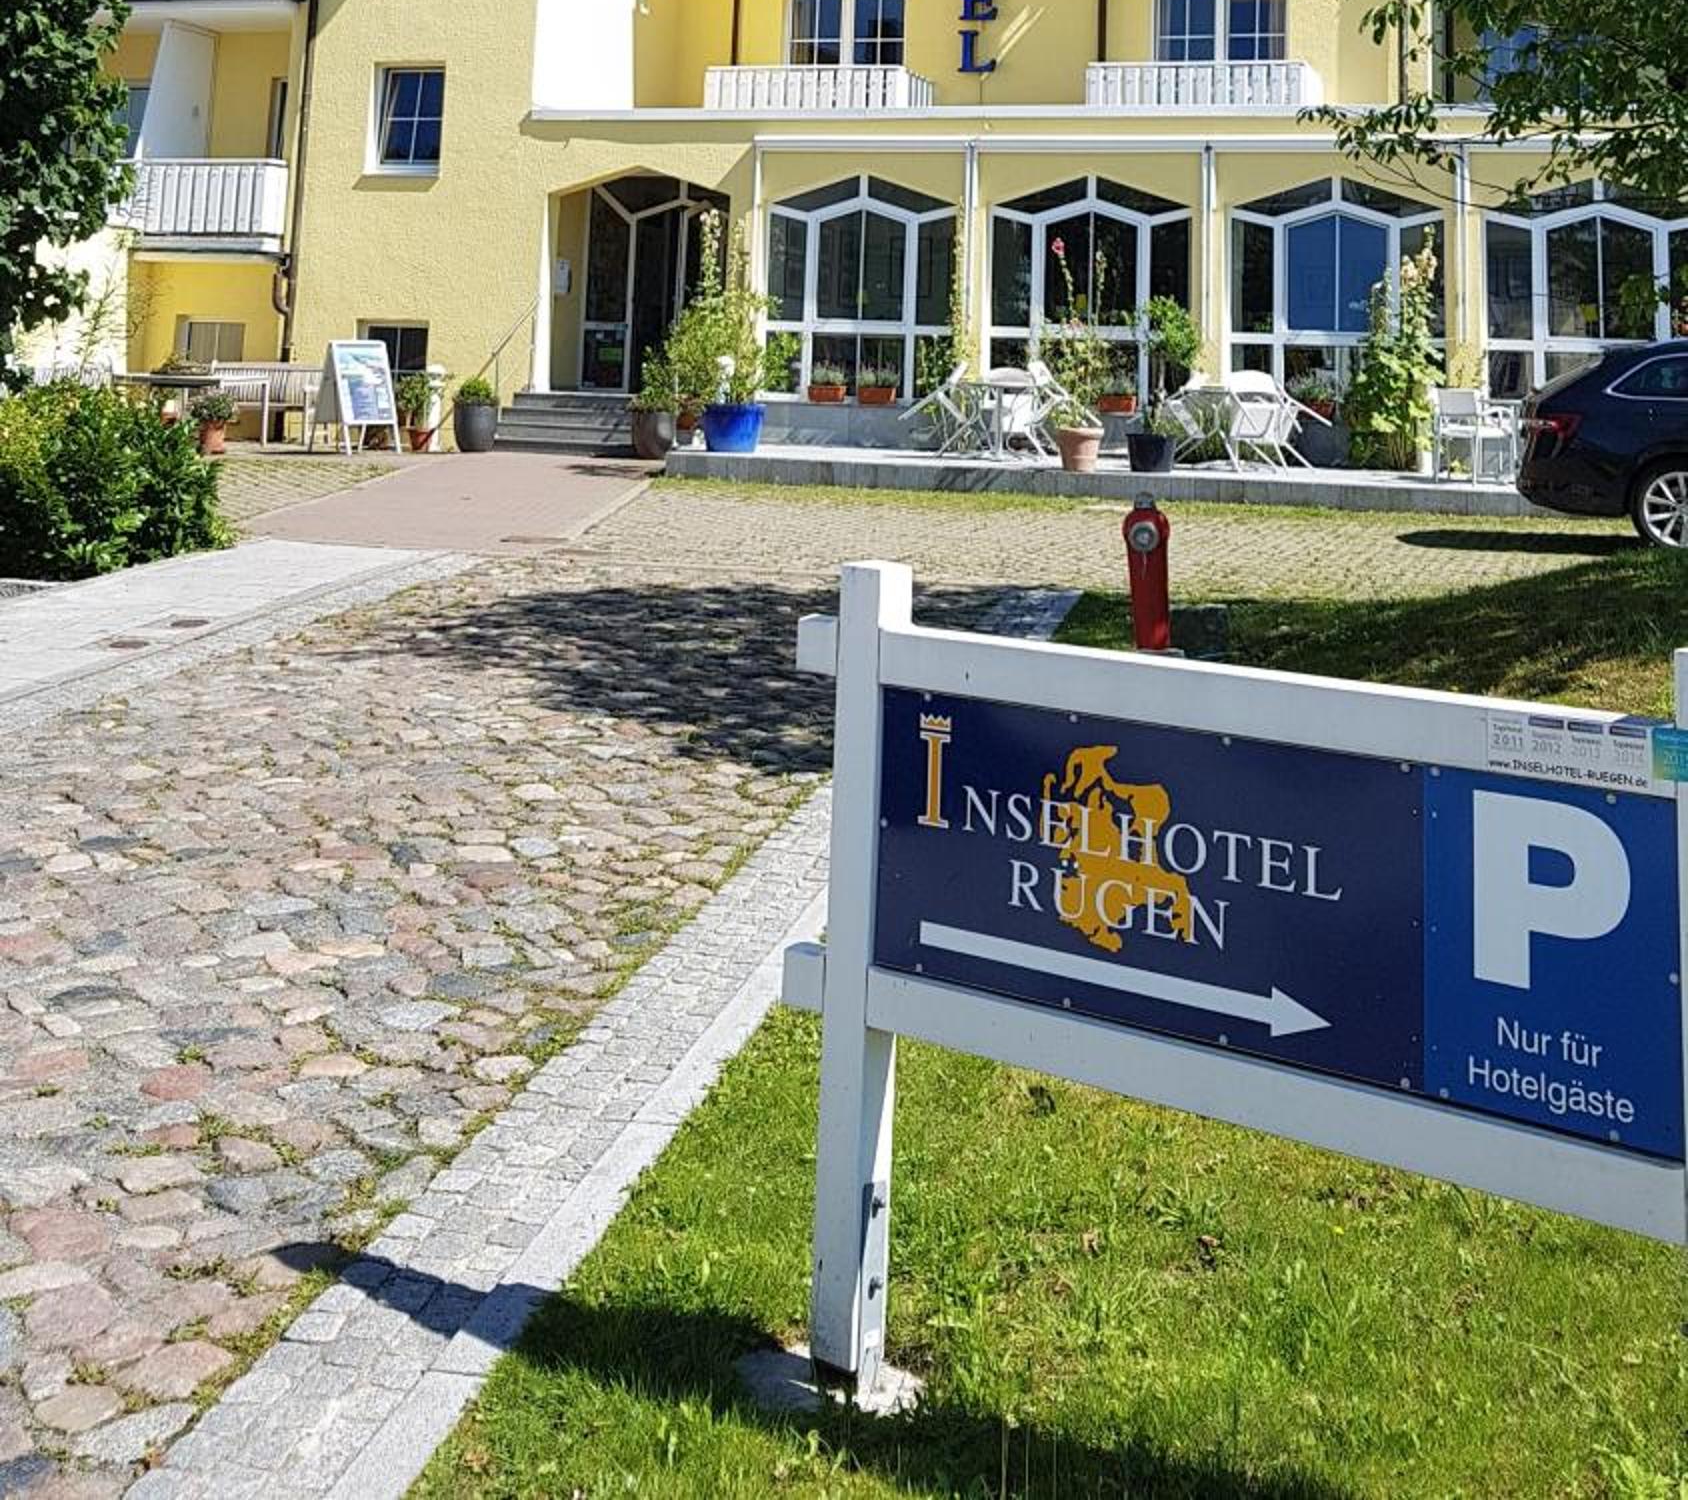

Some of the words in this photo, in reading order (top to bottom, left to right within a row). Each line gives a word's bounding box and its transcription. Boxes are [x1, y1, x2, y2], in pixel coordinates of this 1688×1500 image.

[1493, 733, 1523, 749] 2011
[1532, 739, 1561, 756] 2012
[917, 731, 1342, 901] INSELHOTEL
[1008, 859, 1230, 950] RÜGEN
[1473, 789, 1631, 989] P
[1497, 1017, 1551, 1056] Nur
[1561, 1032, 1602, 1068] für
[1468, 1055, 1634, 1123] Hotelgäste
